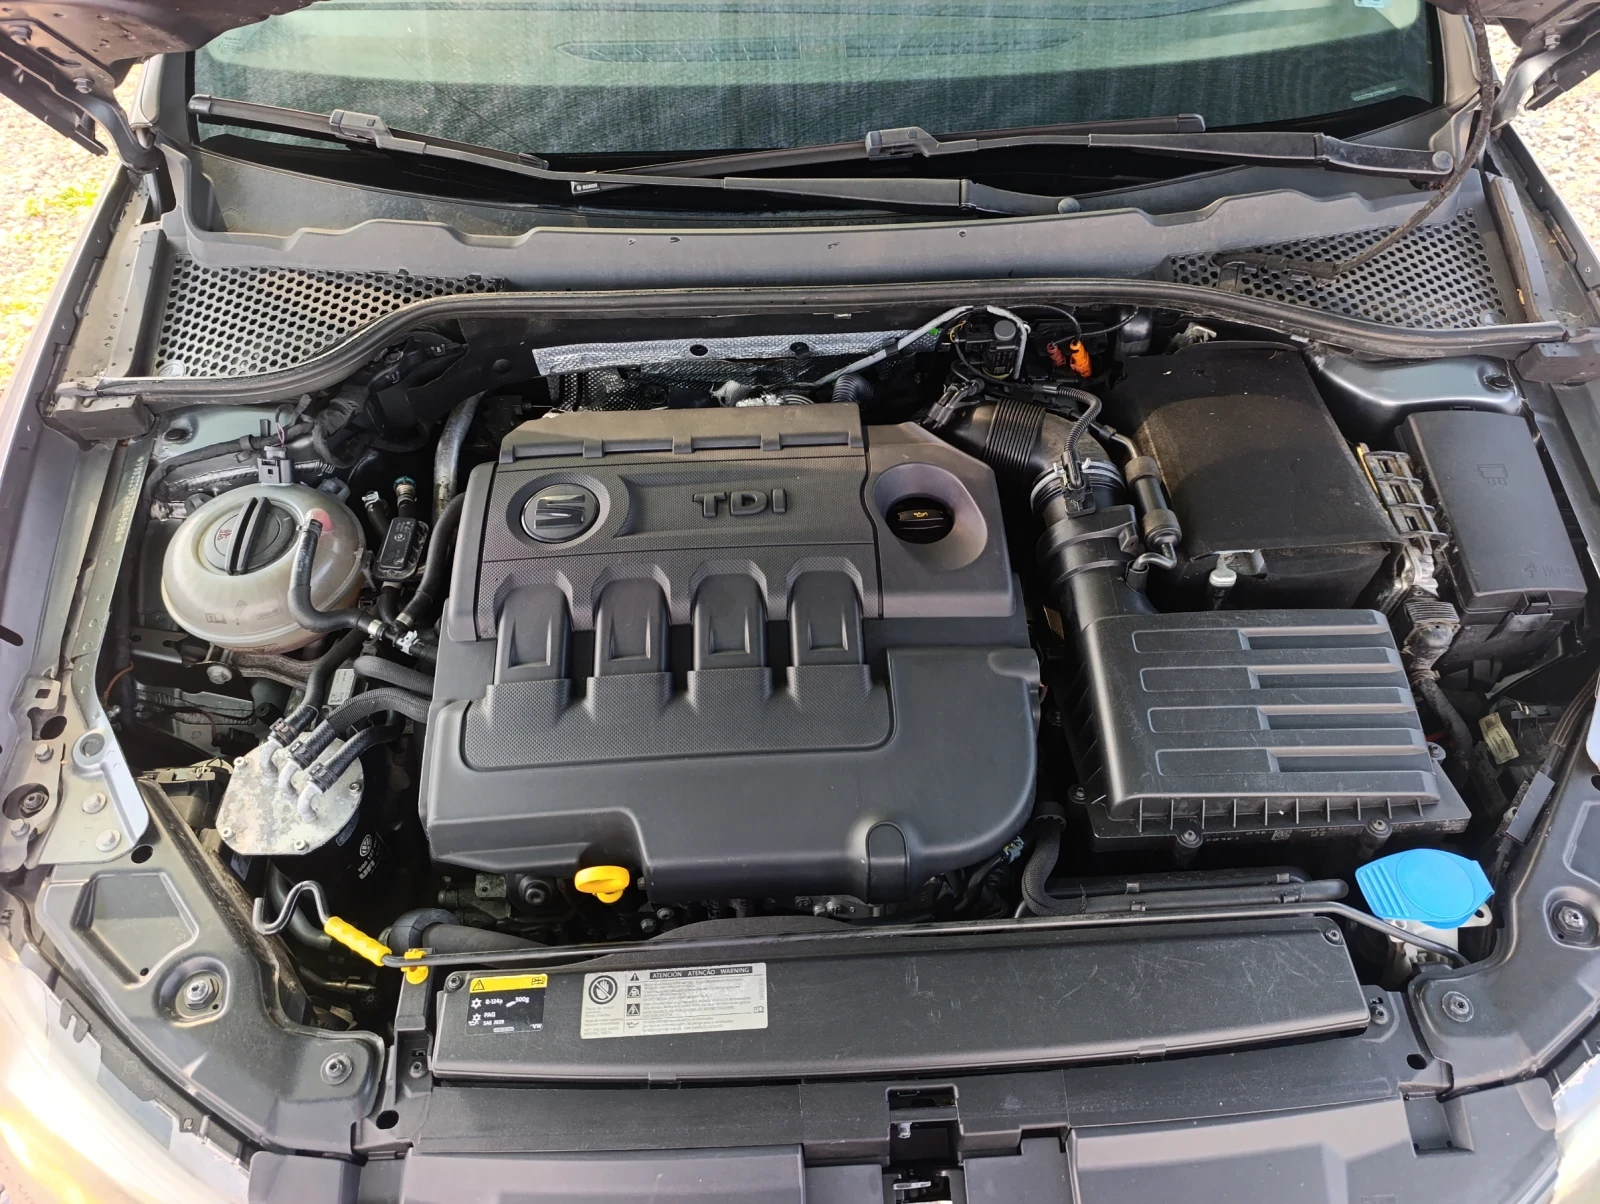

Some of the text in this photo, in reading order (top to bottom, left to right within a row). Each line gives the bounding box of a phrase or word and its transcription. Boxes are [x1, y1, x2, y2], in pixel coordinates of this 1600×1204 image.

[692, 488, 787, 517] TDI
[652, 970, 682, 979] ATENCIÓN
[720, 966, 750, 975] WARNING
